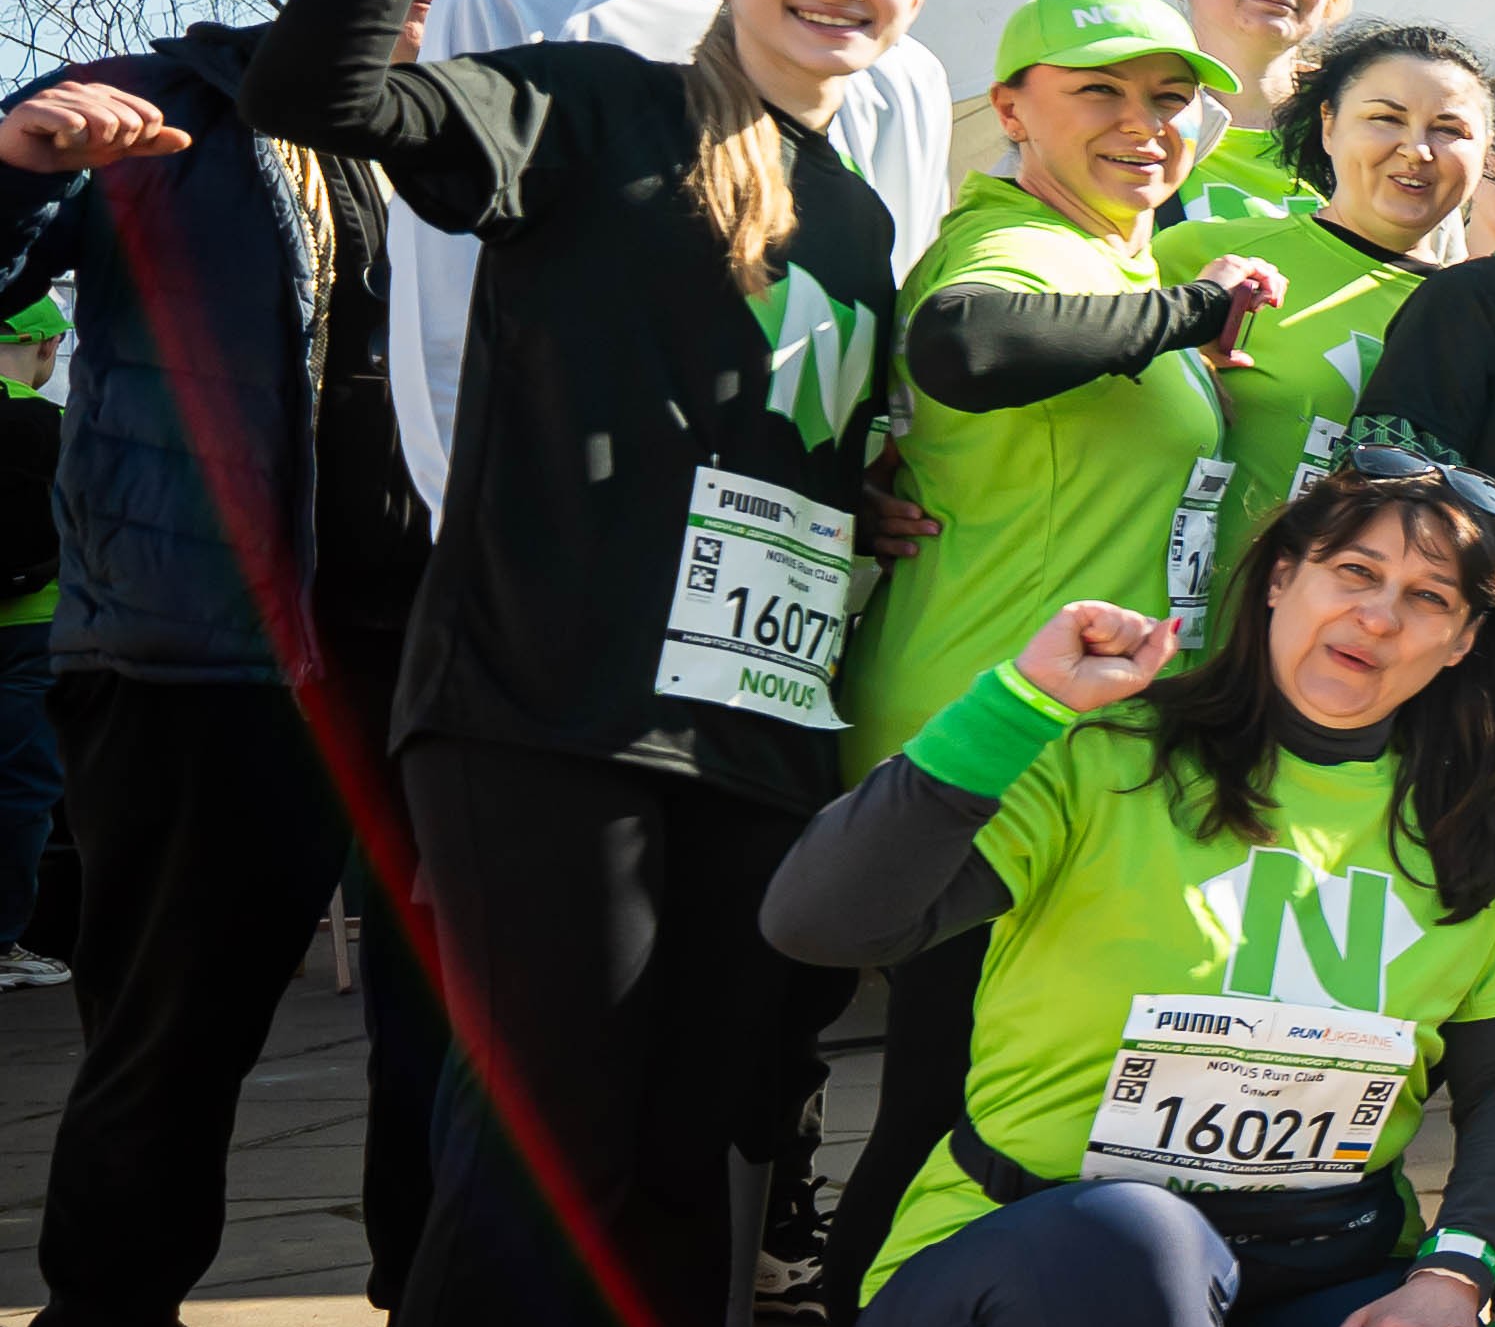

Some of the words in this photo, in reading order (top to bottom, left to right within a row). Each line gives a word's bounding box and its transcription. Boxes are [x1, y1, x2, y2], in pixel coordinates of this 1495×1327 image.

[718, 489, 780, 522] PUMA
[814, 567, 839, 584] Club
[738, 666, 816, 710] NOVUS
[1157, 1011, 1231, 1036] PUMA
[1287, 1025, 1322, 1040] RUN
[1206, 1059, 1258, 1080] NOVUS
[1262, 1067, 1290, 1082] Run
[1294, 1071, 1325, 1084] Club
[1154, 1094, 1336, 1162] 16021
